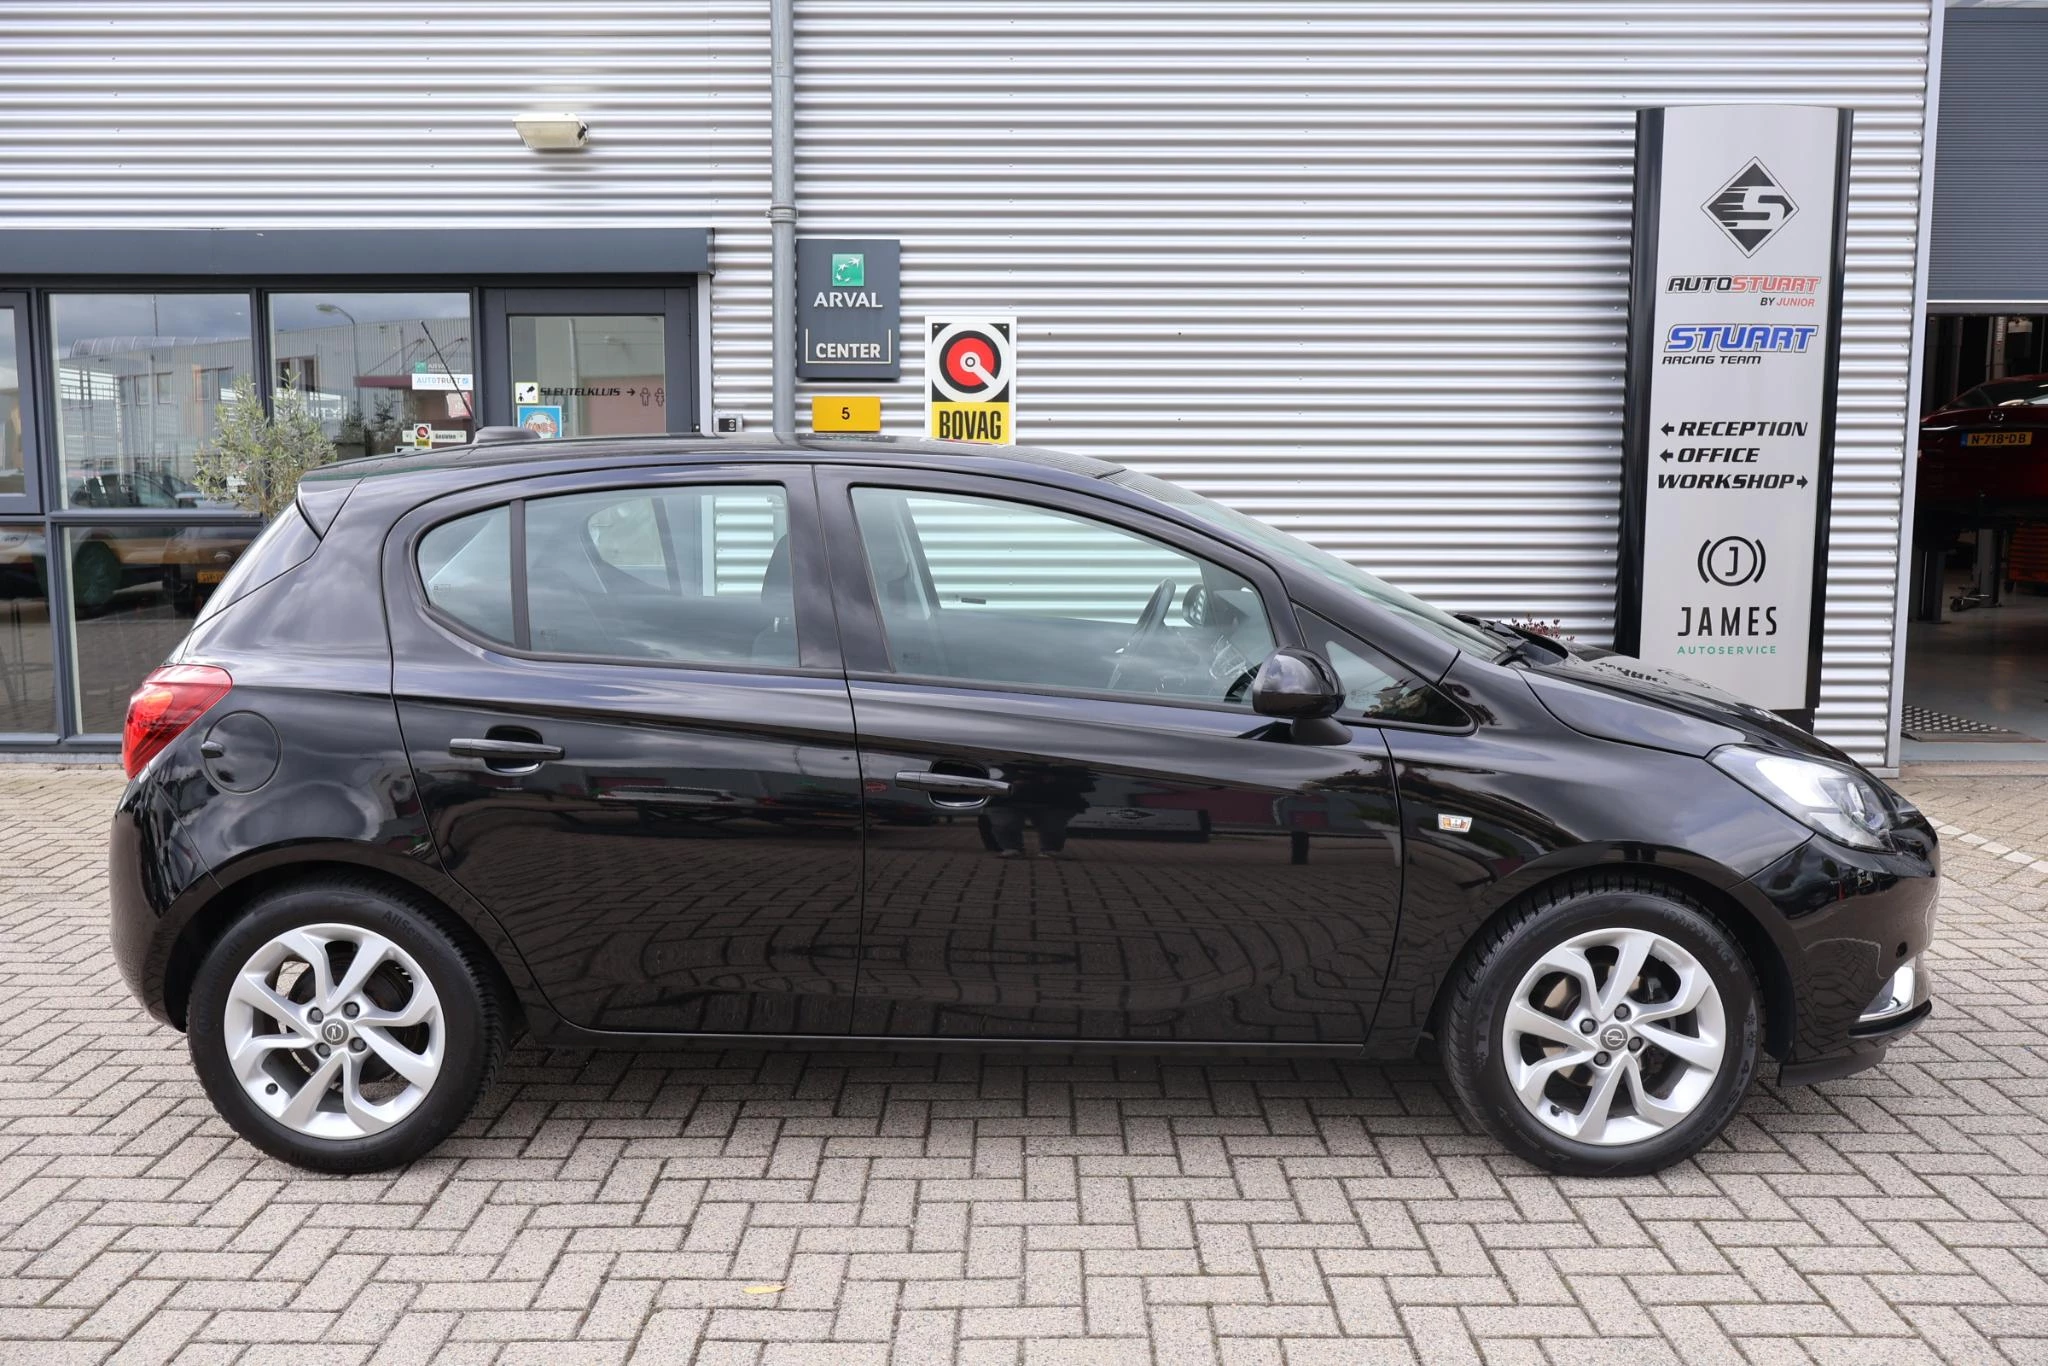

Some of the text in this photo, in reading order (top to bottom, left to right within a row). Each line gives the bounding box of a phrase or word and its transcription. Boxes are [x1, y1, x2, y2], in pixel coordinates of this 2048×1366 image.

[1666, 275, 1821, 293] AUTOSTUART
[813, 292, 883, 308] ARVAL
[1760, 297, 1815, 307] BY JUNIOR
[1665, 325, 1818, 352] STUART
[815, 343, 881, 358] CENTER
[1662, 356, 1761, 365] RACING TEAM
[540, 387, 621, 396] SLEUTELKLUIS
[841, 407, 850, 420] 5
[939, 410, 1002, 440] BOVAG
[1678, 421, 1808, 437] RECEPTION
[1677, 447, 1760, 463] OFFICE
[1657, 474, 1795, 489] WORKSHOP
[1677, 606, 1777, 637] JAMES
[1677, 645, 1777, 655] AUTOSERVICE
